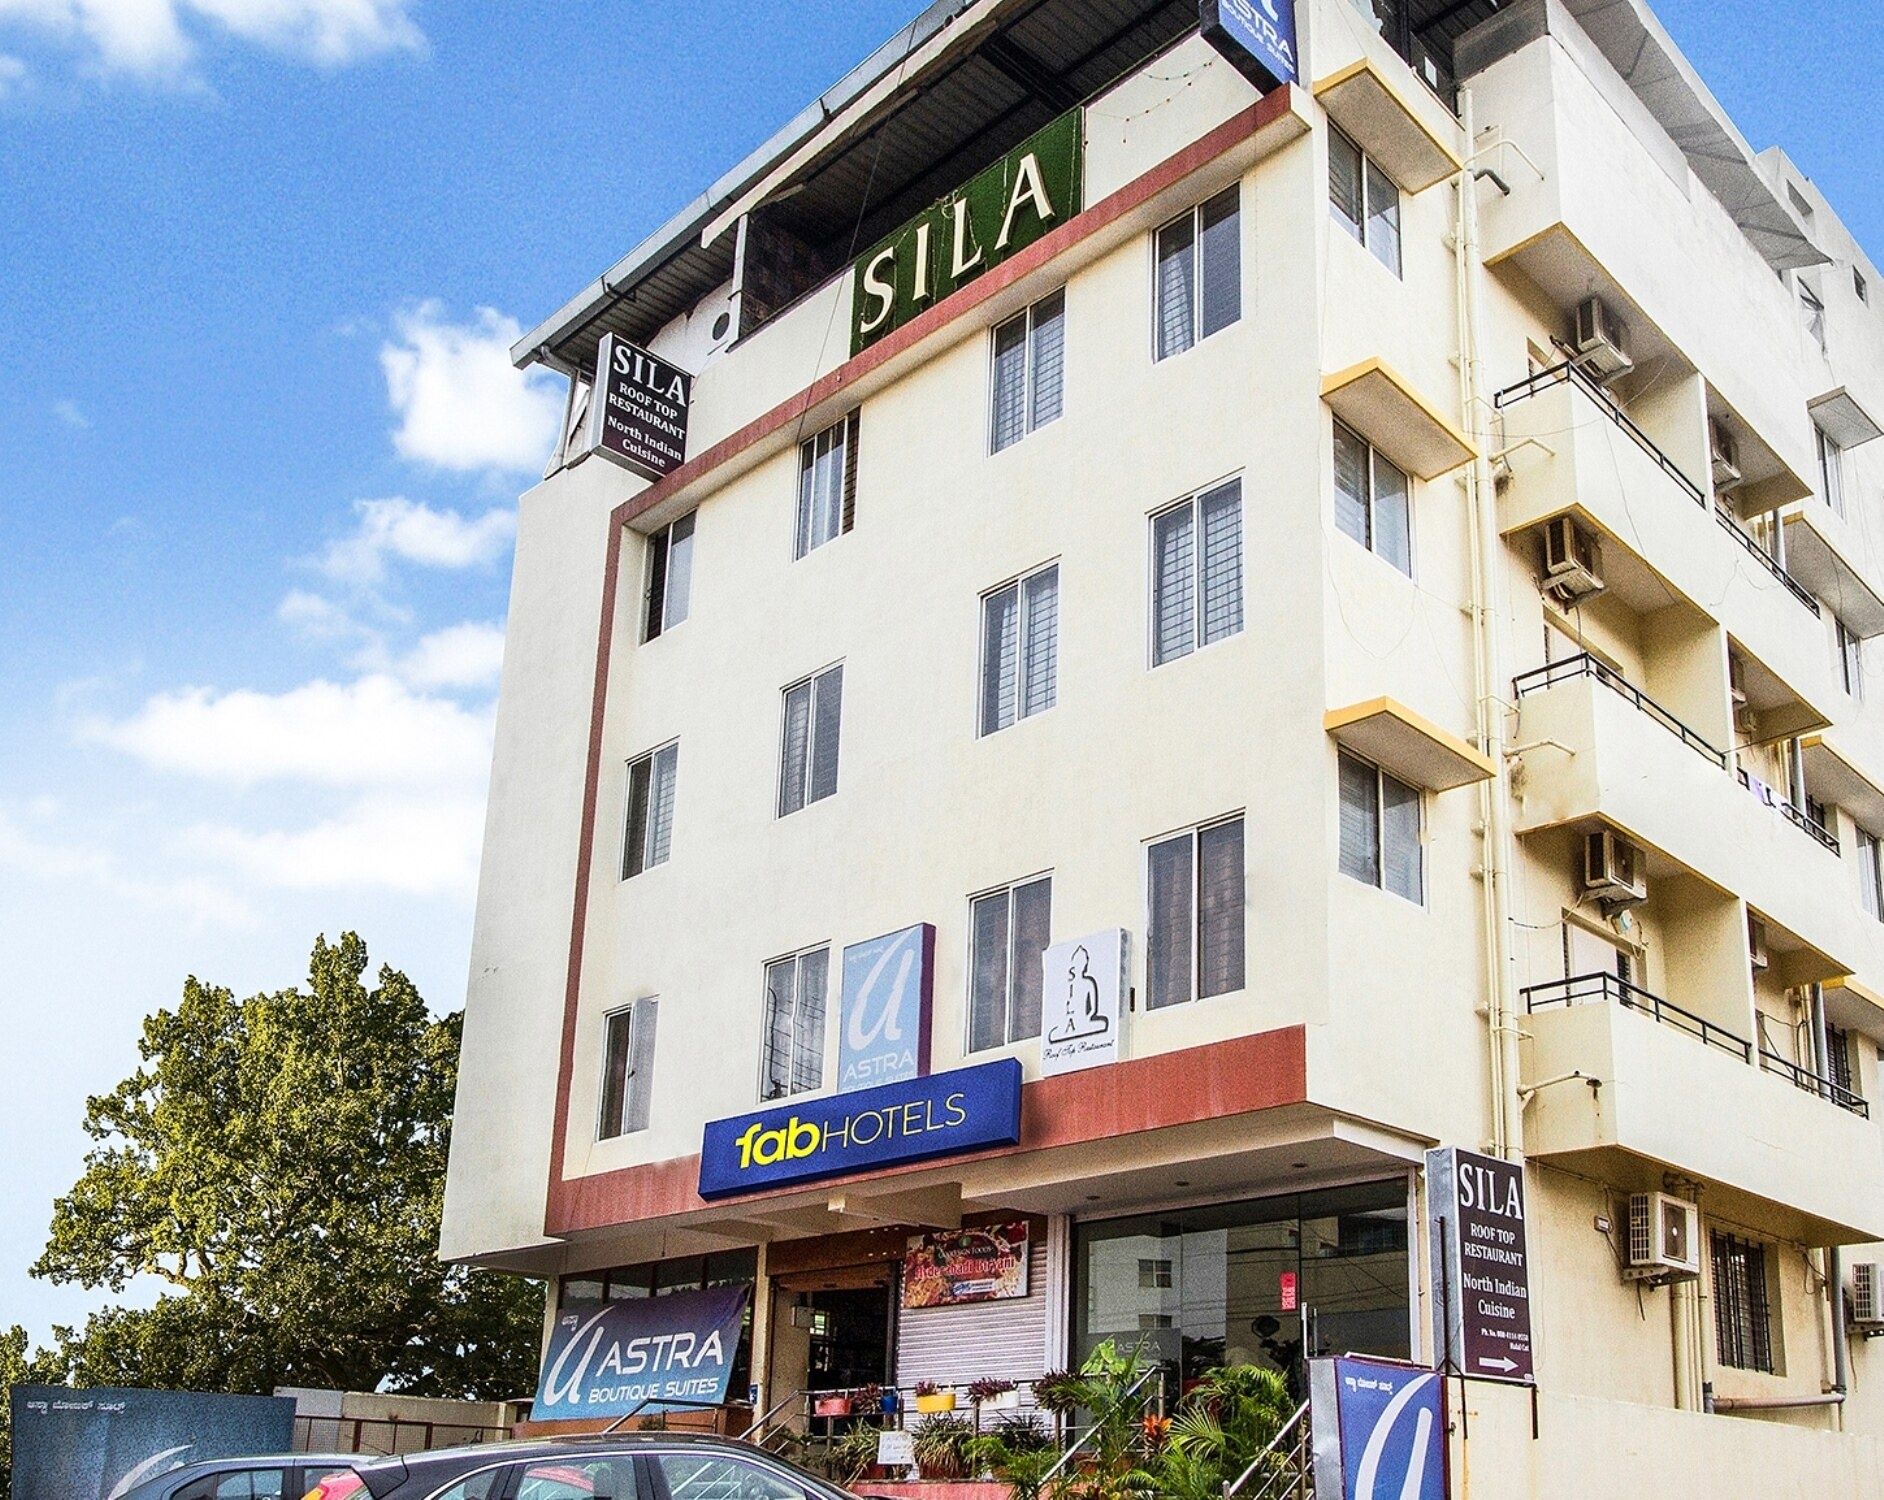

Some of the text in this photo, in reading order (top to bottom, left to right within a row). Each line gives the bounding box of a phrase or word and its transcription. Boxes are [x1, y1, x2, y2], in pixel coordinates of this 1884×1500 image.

[1233, 0, 1293, 62] STRA
[860, 152, 1055, 334] SILA
[613, 345, 686, 407] SILA
[608, 392, 686, 440] RESTAURANT
[619, 381, 678, 419] ROOF TOP
[607, 415, 683, 461] North Indian
[622, 438, 666, 468] Cuisine
[842, 1050, 914, 1083] ASTRA
[1459, 1162, 1523, 1220] SILA
[1470, 1222, 1515, 1245] ROOF TOP
[1464, 1241, 1523, 1267] RESTAURANT
[1463, 1272, 1527, 1299] North Indian
[1478, 1299, 1516, 1320] Cuisine
[595, 1329, 724, 1377] ASTRA
[588, 1378, 719, 1404] BOUTIQUE SUITES
